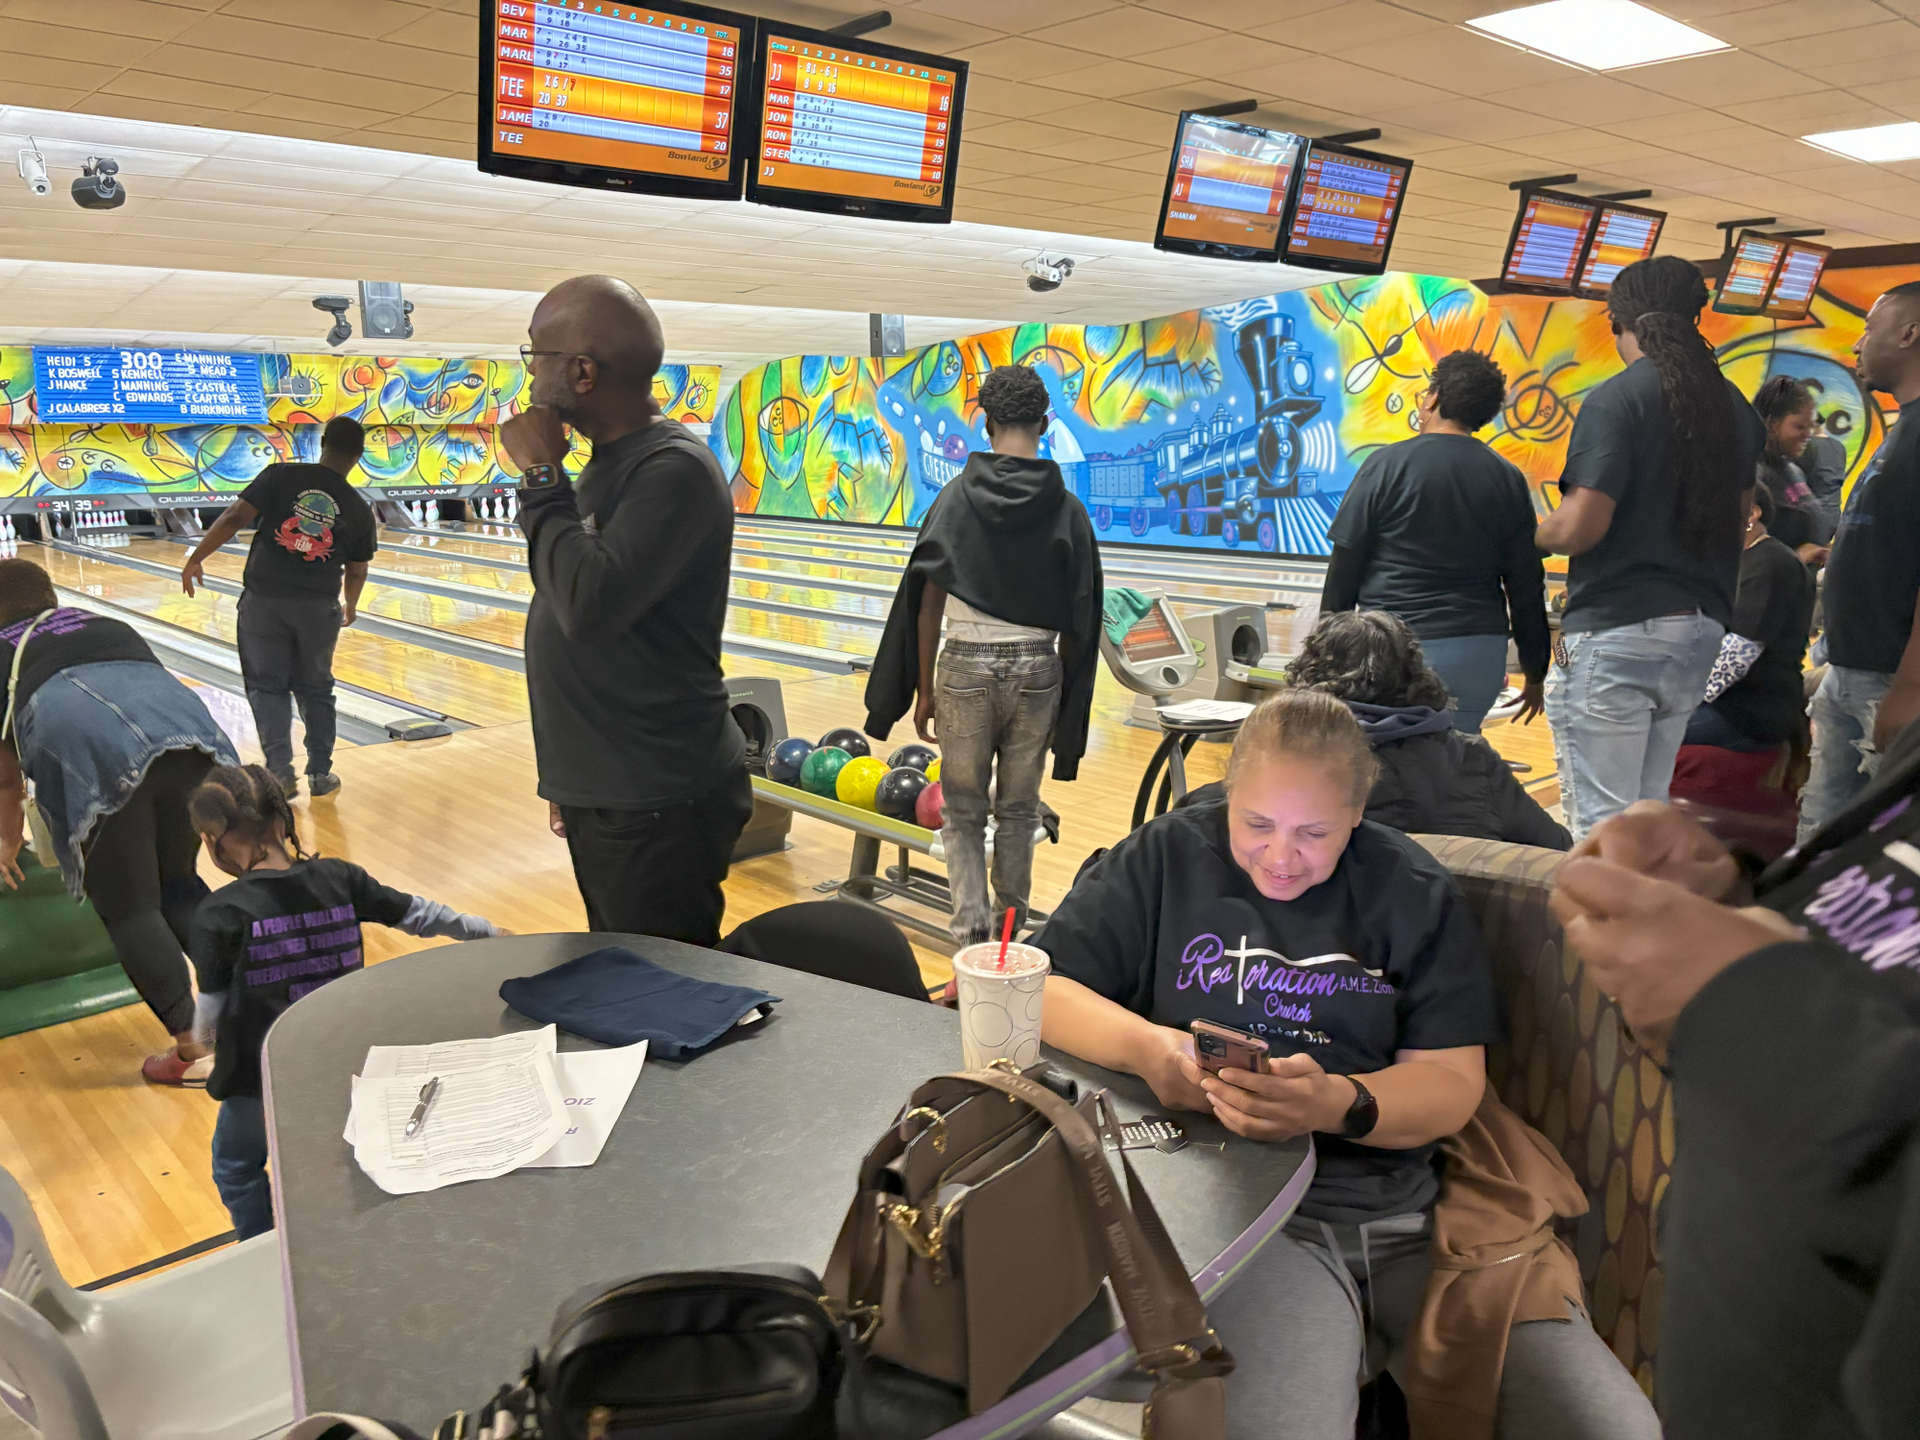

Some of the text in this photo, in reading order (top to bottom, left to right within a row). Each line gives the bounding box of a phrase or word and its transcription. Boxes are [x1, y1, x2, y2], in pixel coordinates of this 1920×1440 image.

[502, 3, 527, 17] BEV
[613, 9, 619, 17] 5
[695, 26, 705, 34] 10
[501, 25, 527, 39] MAR
[501, 47, 533, 61] MARL
[722, 47, 733, 57] 18
[719, 66, 732, 76] 35
[770, 63, 782, 82] JJ
[921, 71, 929, 79] 10
[500, 76, 525, 98] TEE
[720, 86, 730, 95] 17
[804, 78, 836, 94] 8 9 16
[539, 92, 567, 107] 20 37
[769, 93, 790, 105] MAR
[939, 96, 949, 112] 16
[500, 110, 532, 123] JAME
[716, 112, 729, 129] 37
[768, 111, 787, 123] JON
[937, 122, 947, 131] 19
[500, 131, 523, 144] TEE
[766, 130, 787, 141] RON
[714, 141, 726, 150] 20
[935, 138, 945, 147] 19
[668, 151, 708, 163] Bowland
[765, 147, 790, 159] STER
[932, 154, 942, 164] 25
[1180, 155, 1194, 170] SHA
[763, 166, 775, 177] JJ
[932, 171, 941, 180] 10
[1174, 183, 1184, 196] AJ
[46, 355, 91, 367] HEIDI S
[120, 351, 162, 370] 300
[175, 353, 231, 365] E MANNING
[48, 368, 103, 379] K BOSWELL
[111, 369, 165, 380] S KENNELL
[188, 365, 237, 377] S MEAD 2
[47, 380, 88, 390] J HANCE
[113, 381, 169, 391] J MANNING
[185, 382, 238, 393] S CASTILLE
[113, 392, 174, 402] C EDWARDS
[185, 393, 241, 404] C CARTER 2
[47, 403, 126, 413] J CALABRESE X2
[180, 404, 248, 415] B BURKINDINE
[504, 488, 516, 497] 38
[52, 500, 70, 511] 34
[295, 538, 312, 552] TEAM
[252, 921, 263, 938] A
[1340, 976, 1372, 993] A.M.E.
[1373, 978, 1395, 995] Zion
[1264, 992, 1312, 1023] Church
[564, 1097, 596, 1106] ZIO
